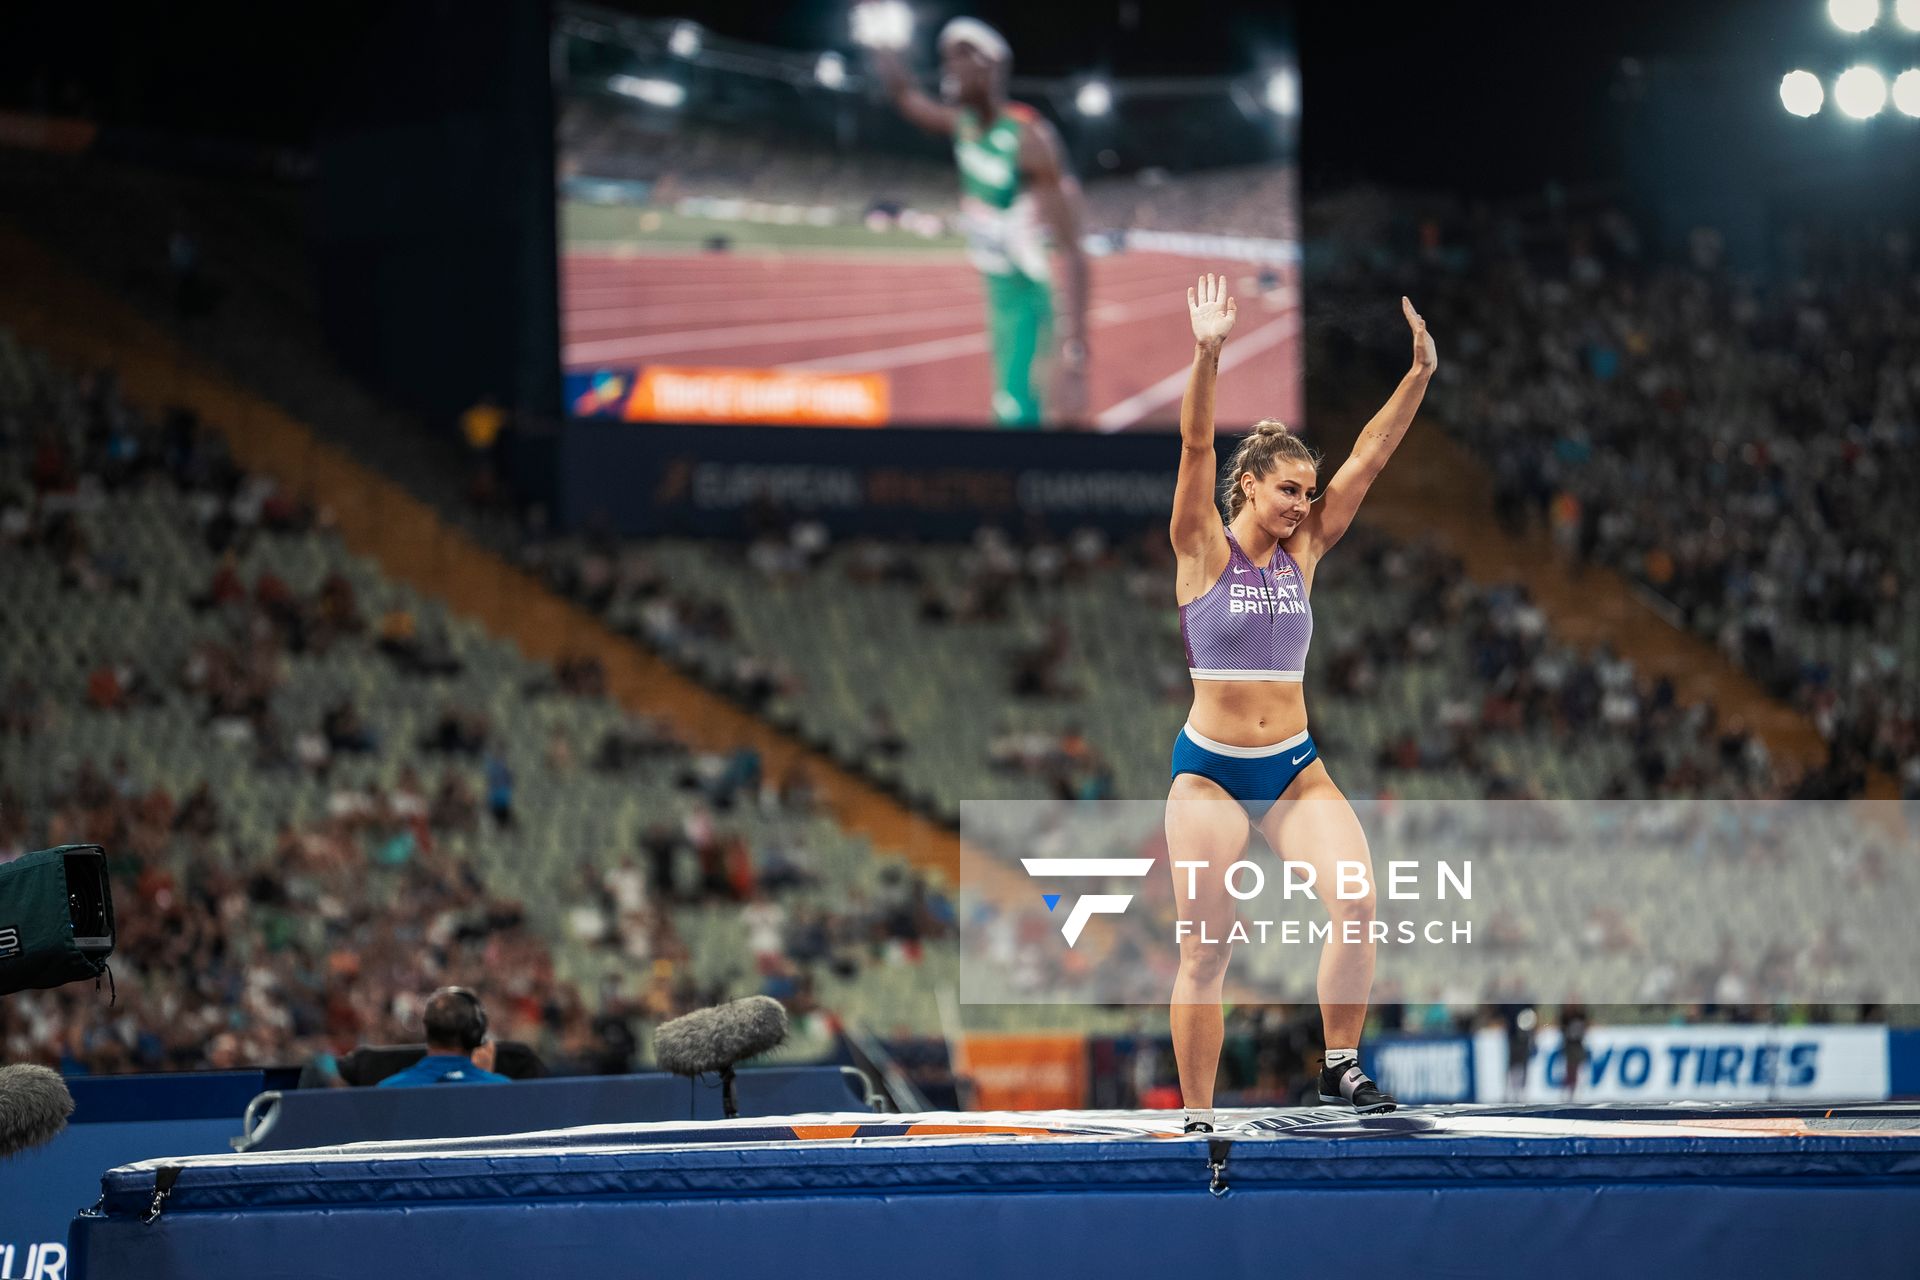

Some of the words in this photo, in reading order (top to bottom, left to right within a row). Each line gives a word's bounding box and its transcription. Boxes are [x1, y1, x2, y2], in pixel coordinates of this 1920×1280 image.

[1230, 584, 1298, 599] GREAT
[1230, 601, 1305, 614] BRITAIN
[1668, 1046, 1819, 1086] TIRES
